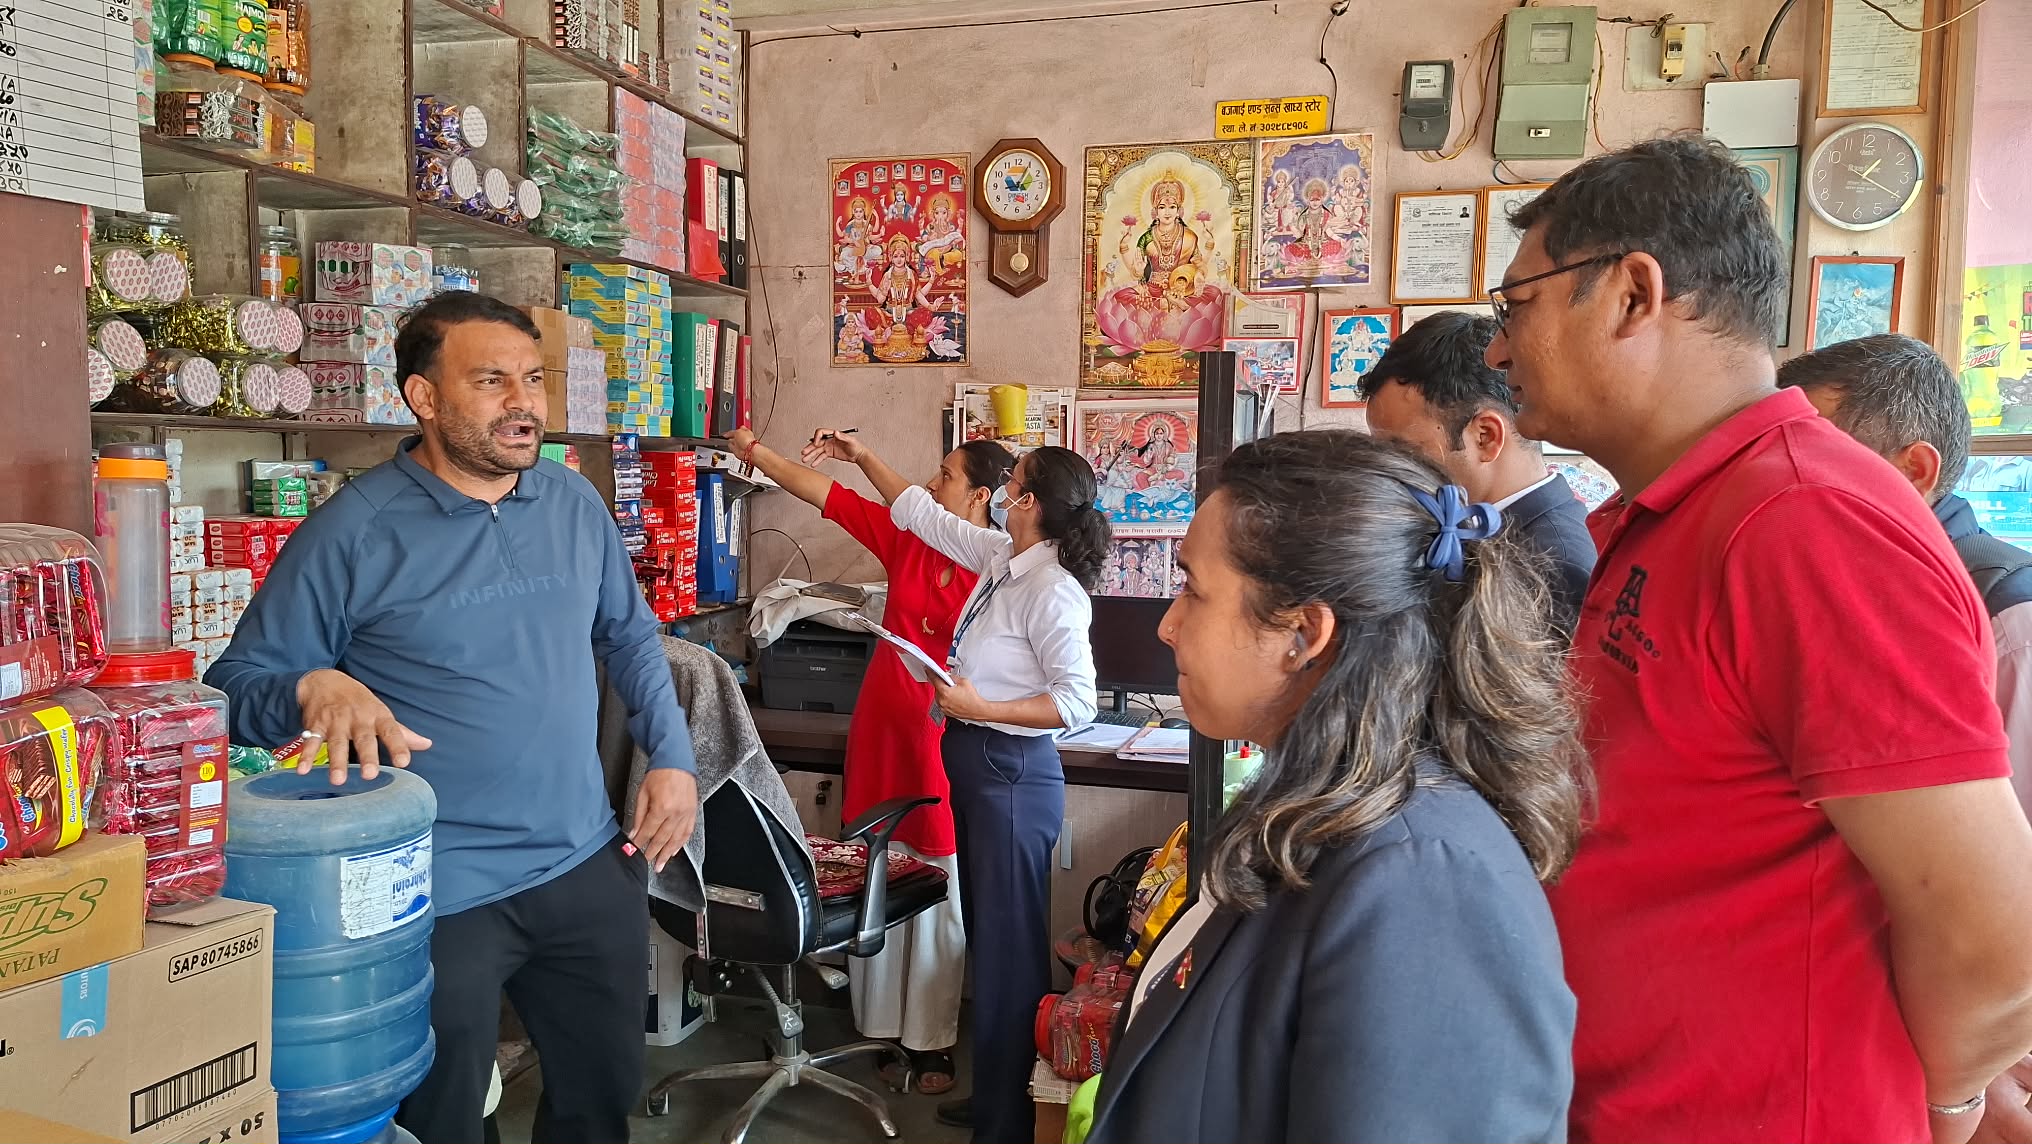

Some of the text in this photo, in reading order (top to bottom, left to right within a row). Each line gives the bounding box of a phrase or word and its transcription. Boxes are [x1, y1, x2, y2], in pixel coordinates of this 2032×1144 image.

[1264, 103, 1281, 114] सन्स
[1304, 98, 1322, 112] स्टोर
[1844, 138, 1853, 151] 11
[1863, 134, 1876, 148] 12
[1015, 158, 1023, 166] 12
[1828, 150, 1842, 164] 10
[1896, 152, 1906, 166] 2
[994, 170, 1003, 178] 10
[1817, 169, 1827, 183] 9
[1899, 171, 1909, 184] 3
[993, 182, 998, 190] 9
[1820, 188, 1830, 201] 8
[1003, 203, 1009, 211] 7
[1014, 205, 1020, 213] 6
[1026, 203, 1031, 211] 5
[1834, 201, 1844, 215] 7
[1852, 206, 1862, 220] 6
[1872, 202, 1882, 215] 5
[184, 555, 199, 565] LUX
[449, 571, 568, 609] INFINITY
[203, 623, 218, 632] LUX
[172, 934, 259, 976] SAP 80745866
[240, 1111, 265, 1136] 50
